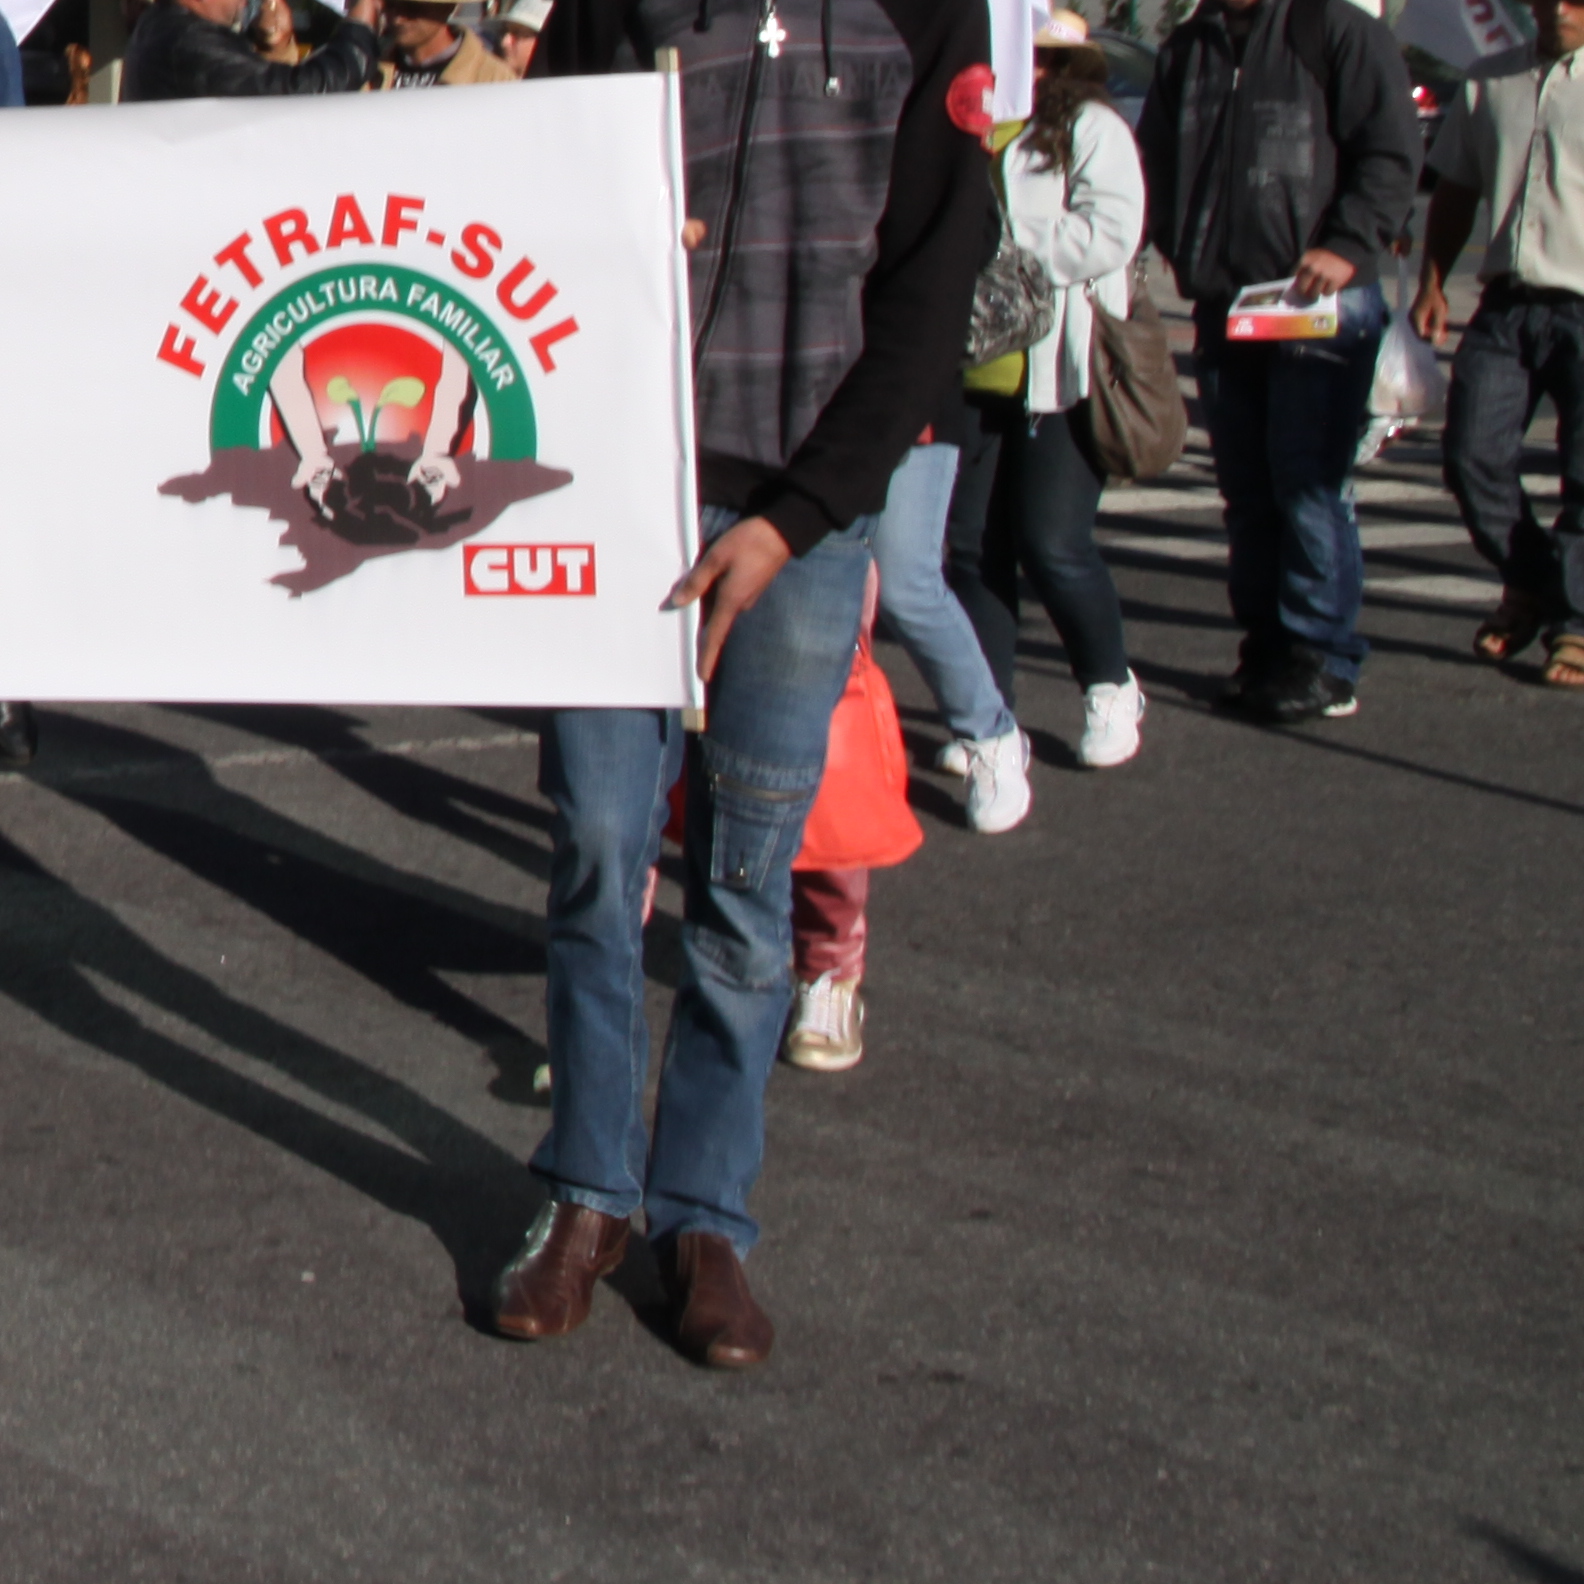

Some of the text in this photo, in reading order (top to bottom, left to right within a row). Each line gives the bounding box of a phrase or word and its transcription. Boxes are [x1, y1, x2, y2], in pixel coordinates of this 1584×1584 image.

[157, 192, 579, 379] FETRAF-SUL
[232, 274, 516, 397] AGRICULTURA FAMILIAR
[469, 547, 590, 593] CUT
